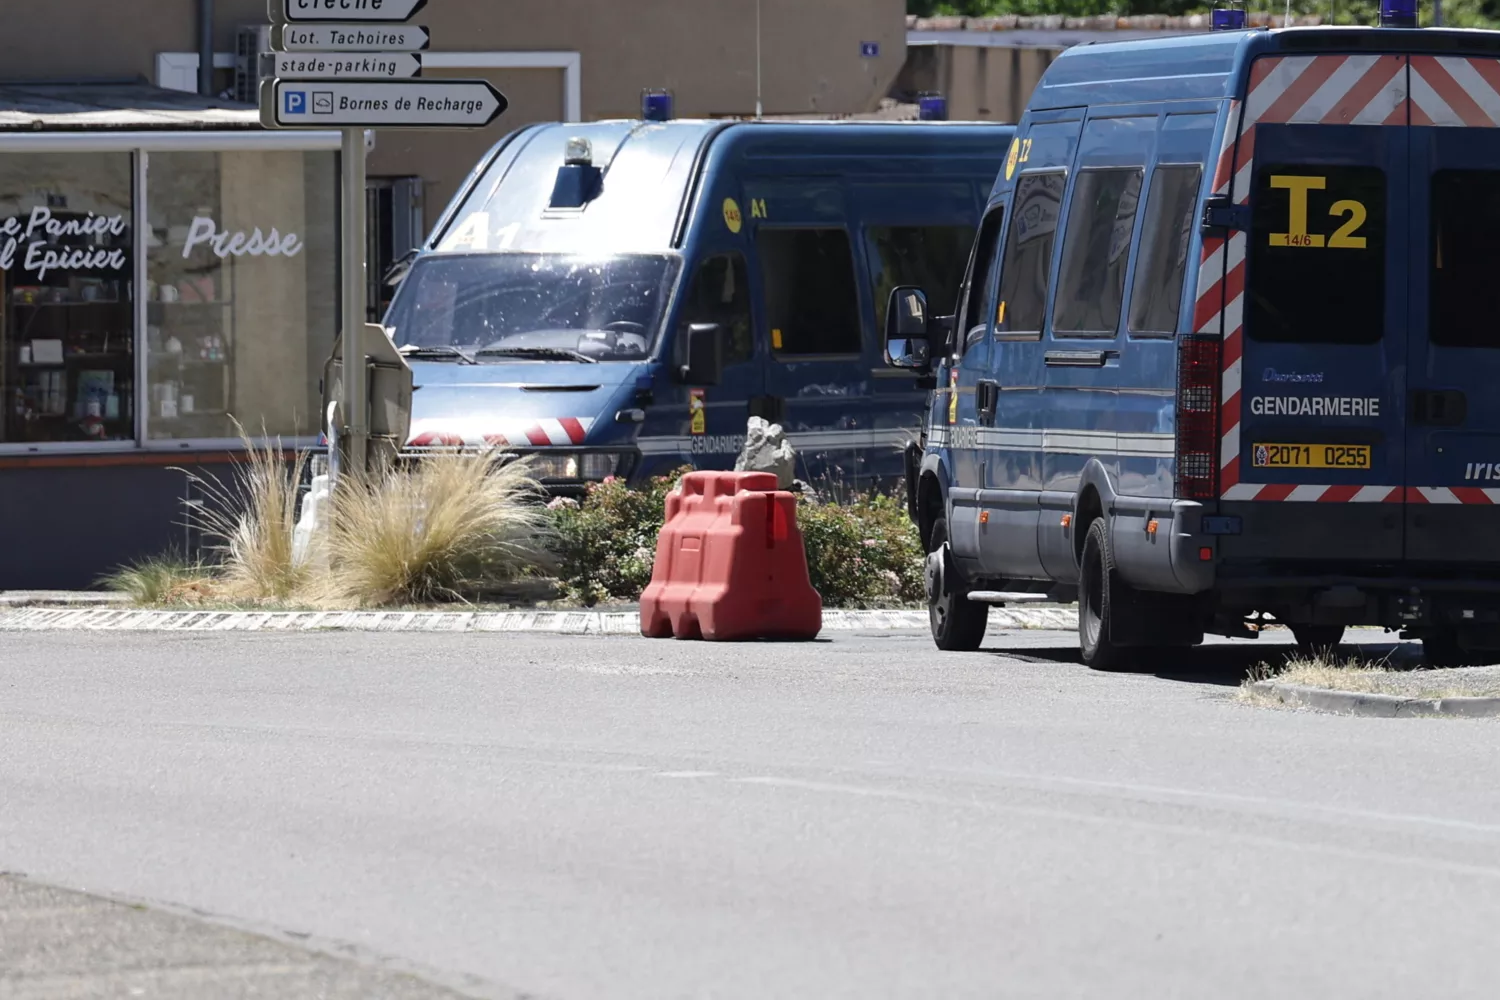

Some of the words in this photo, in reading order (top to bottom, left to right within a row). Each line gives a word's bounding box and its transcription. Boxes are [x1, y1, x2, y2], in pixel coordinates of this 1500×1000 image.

[290, 31, 320, 45] Lot.
[330, 31, 405, 45] Tachoires
[280, 58, 397, 75] stade-parking
[339, 96, 388, 111] Bornes
[395, 96, 411, 111] de
[417, 97, 483, 113] Recharge
[751, 198, 767, 218] A1
[0, 216, 22, 236] e
[26, 205, 126, 237] Panier
[182, 215, 302, 258] Presse
[1284, 234, 1311, 246] 14/6
[1250, 396, 1380, 416] GENDARMERIE
[1269, 446, 1311, 465] 2071
[1324, 447, 1368, 466] 0255
